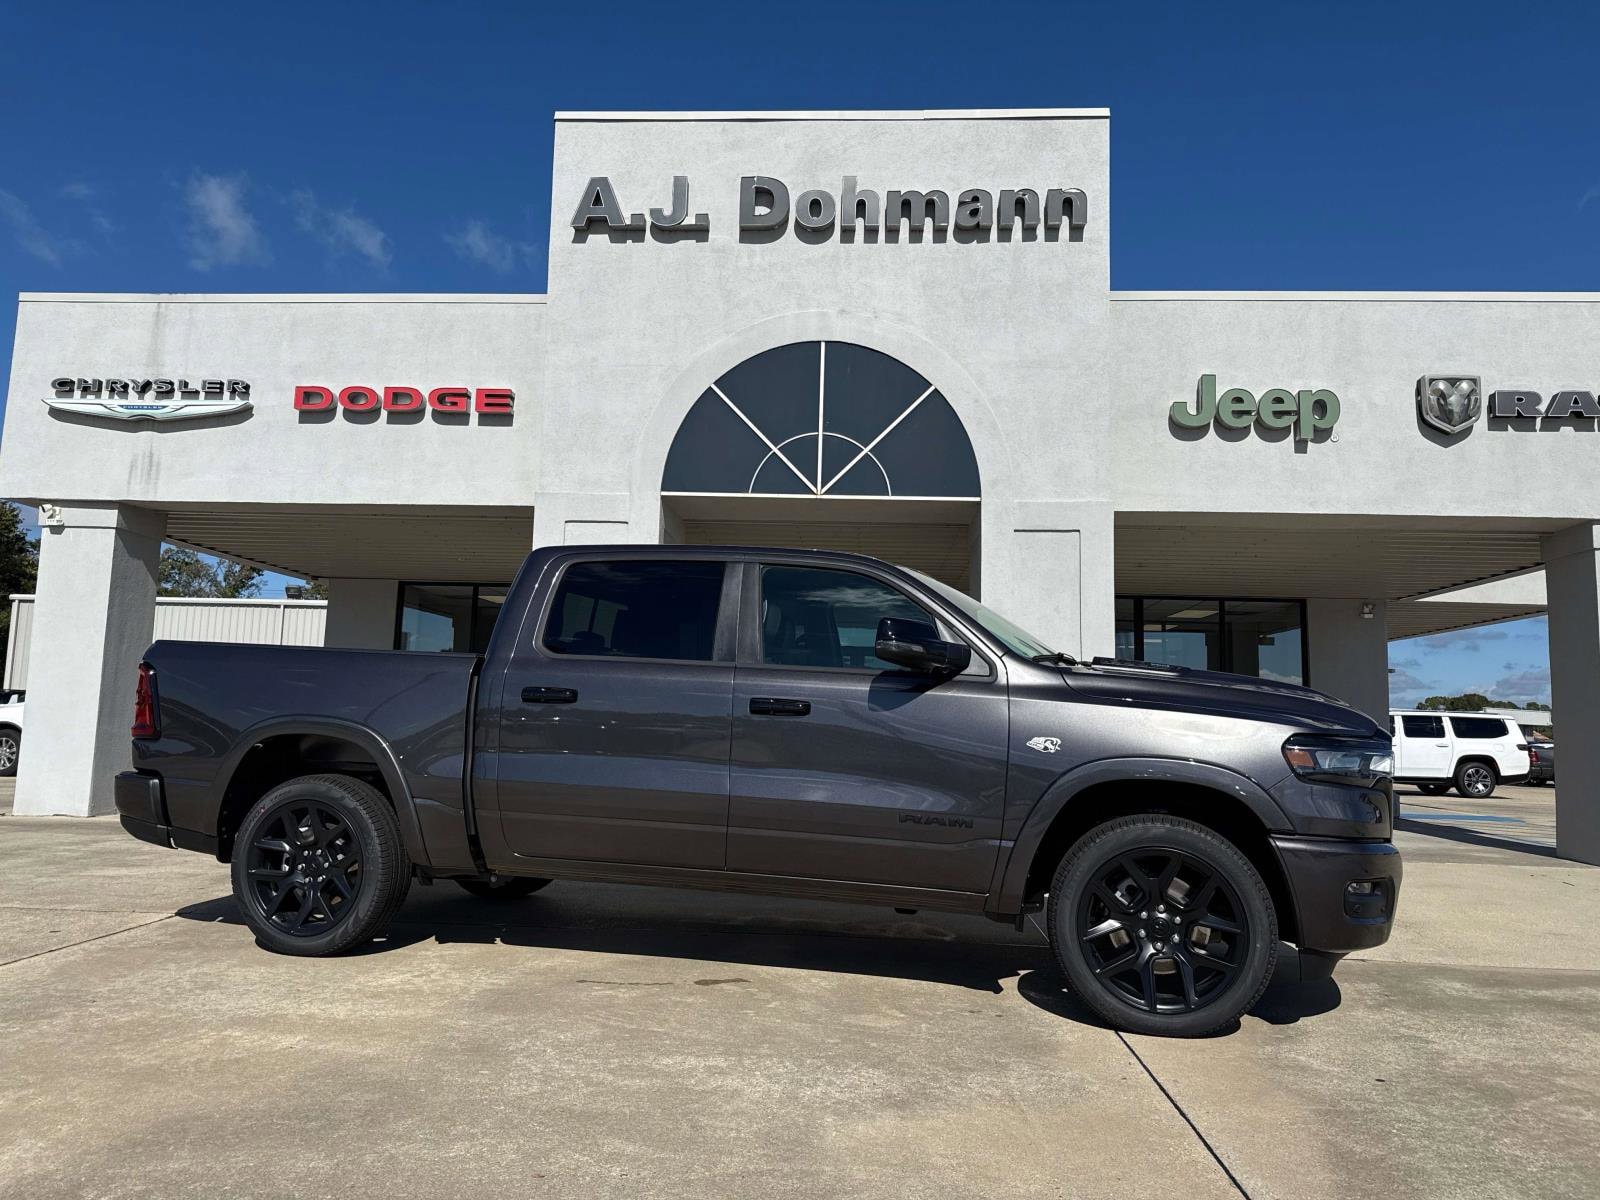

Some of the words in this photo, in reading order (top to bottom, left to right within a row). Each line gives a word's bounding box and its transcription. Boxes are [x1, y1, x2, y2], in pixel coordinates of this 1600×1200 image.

[571, 176, 709, 230] A.J.
[739, 176, 1087, 231] Dohmann
[51, 377, 251, 395] CHRYSLER
[295, 385, 515, 414] DODGE
[1169, 374, 1340, 440] Jeep
[1490, 389, 1600, 417] RA
